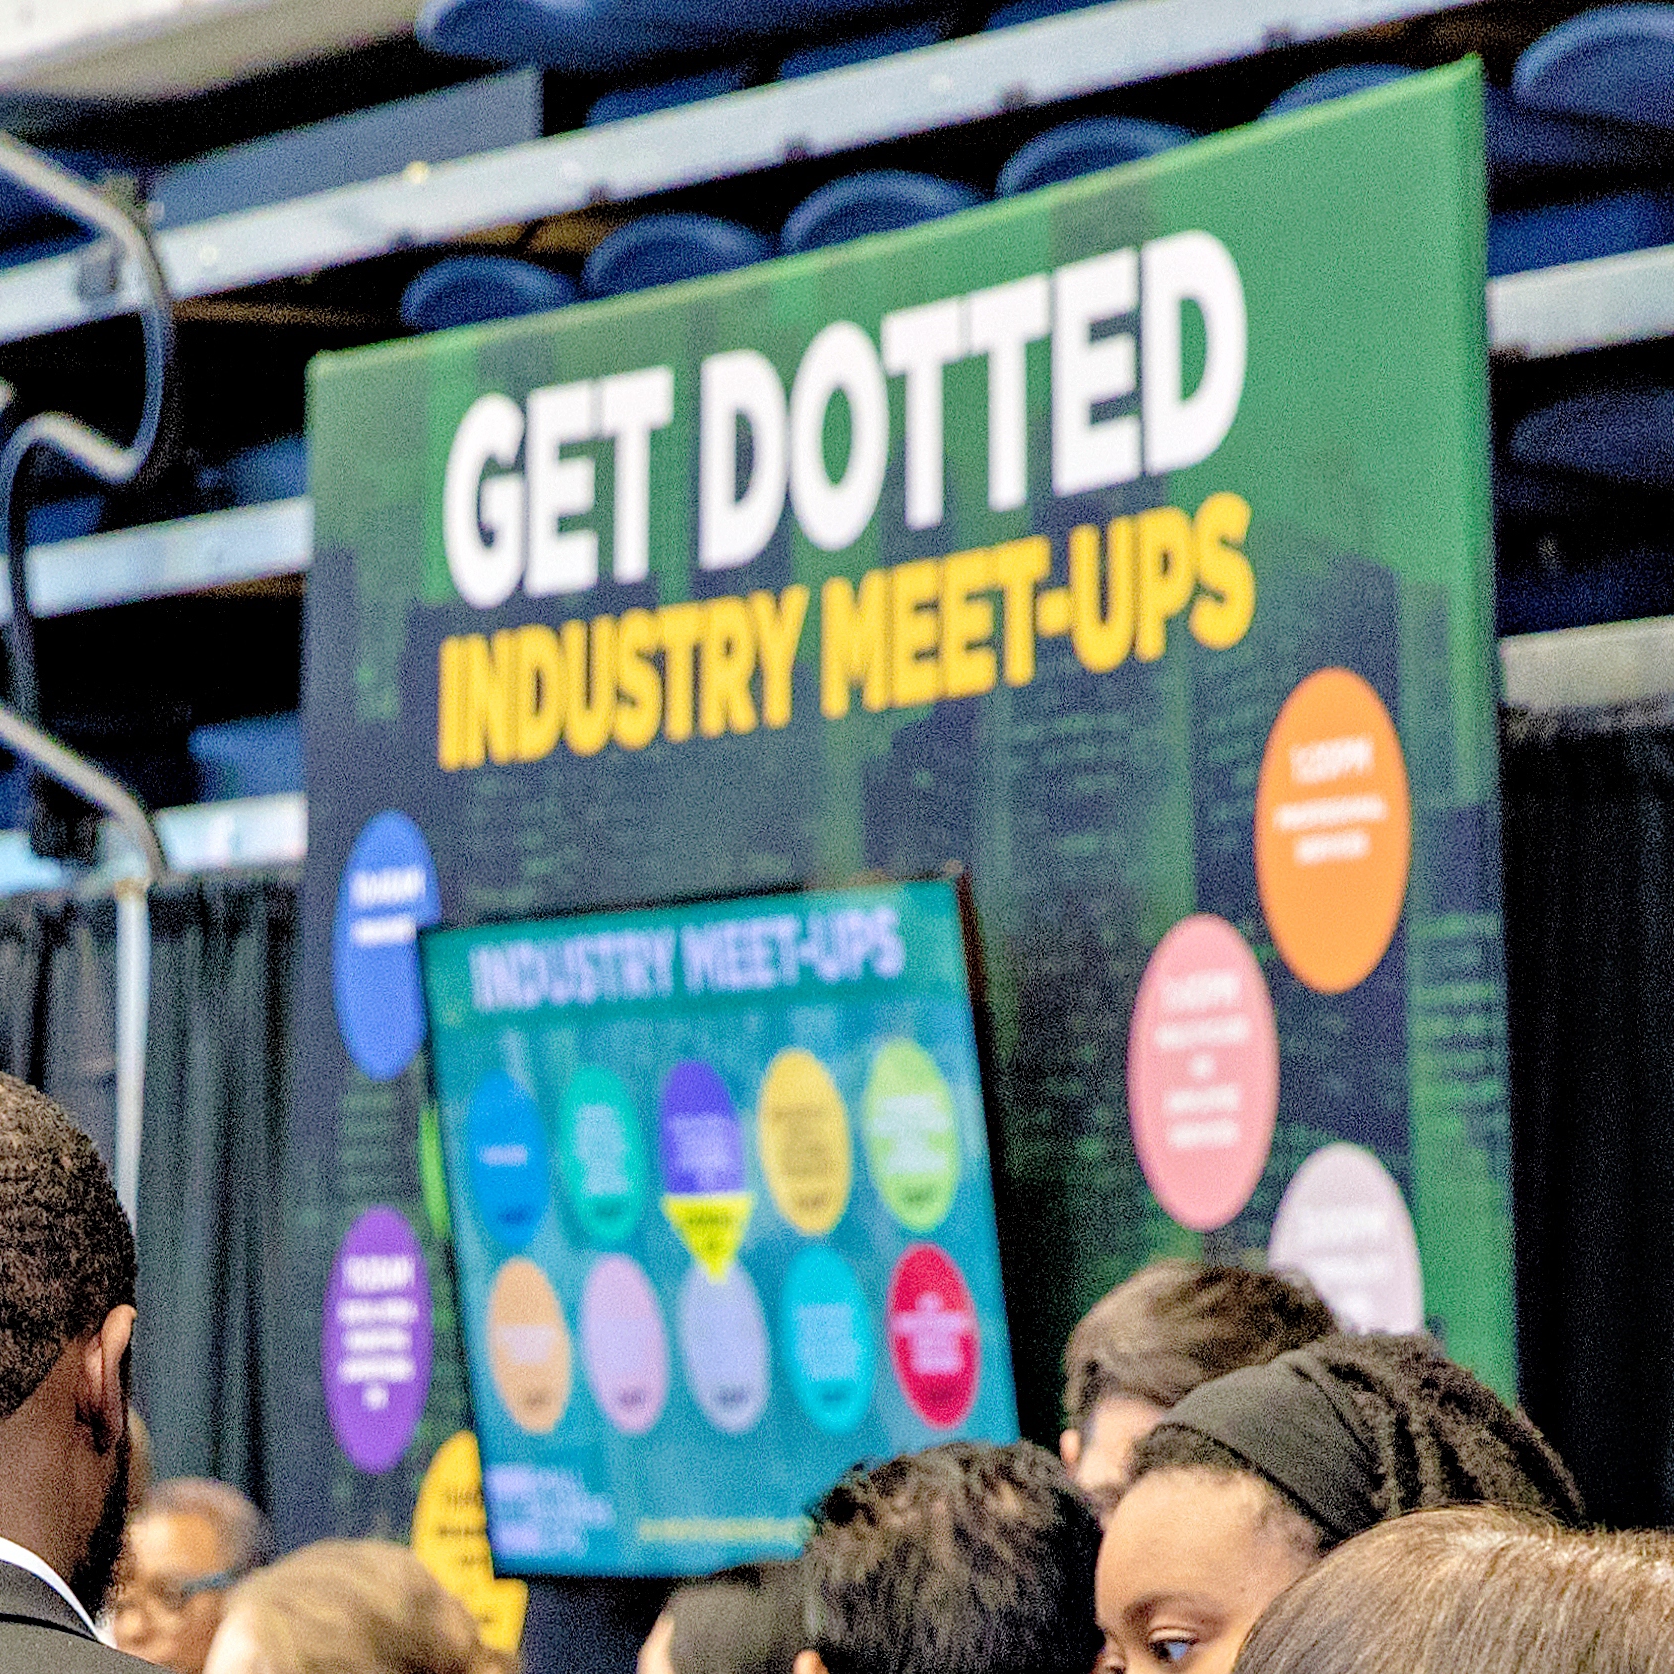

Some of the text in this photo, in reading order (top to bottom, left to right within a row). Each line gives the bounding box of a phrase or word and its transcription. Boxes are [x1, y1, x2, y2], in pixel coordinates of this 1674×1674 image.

[444, 231, 1248, 608] GET DOTTED
[438, 493, 1255, 772] INDUSTRY MEET-UPS
[469, 929, 677, 1012] INDUSTRY
